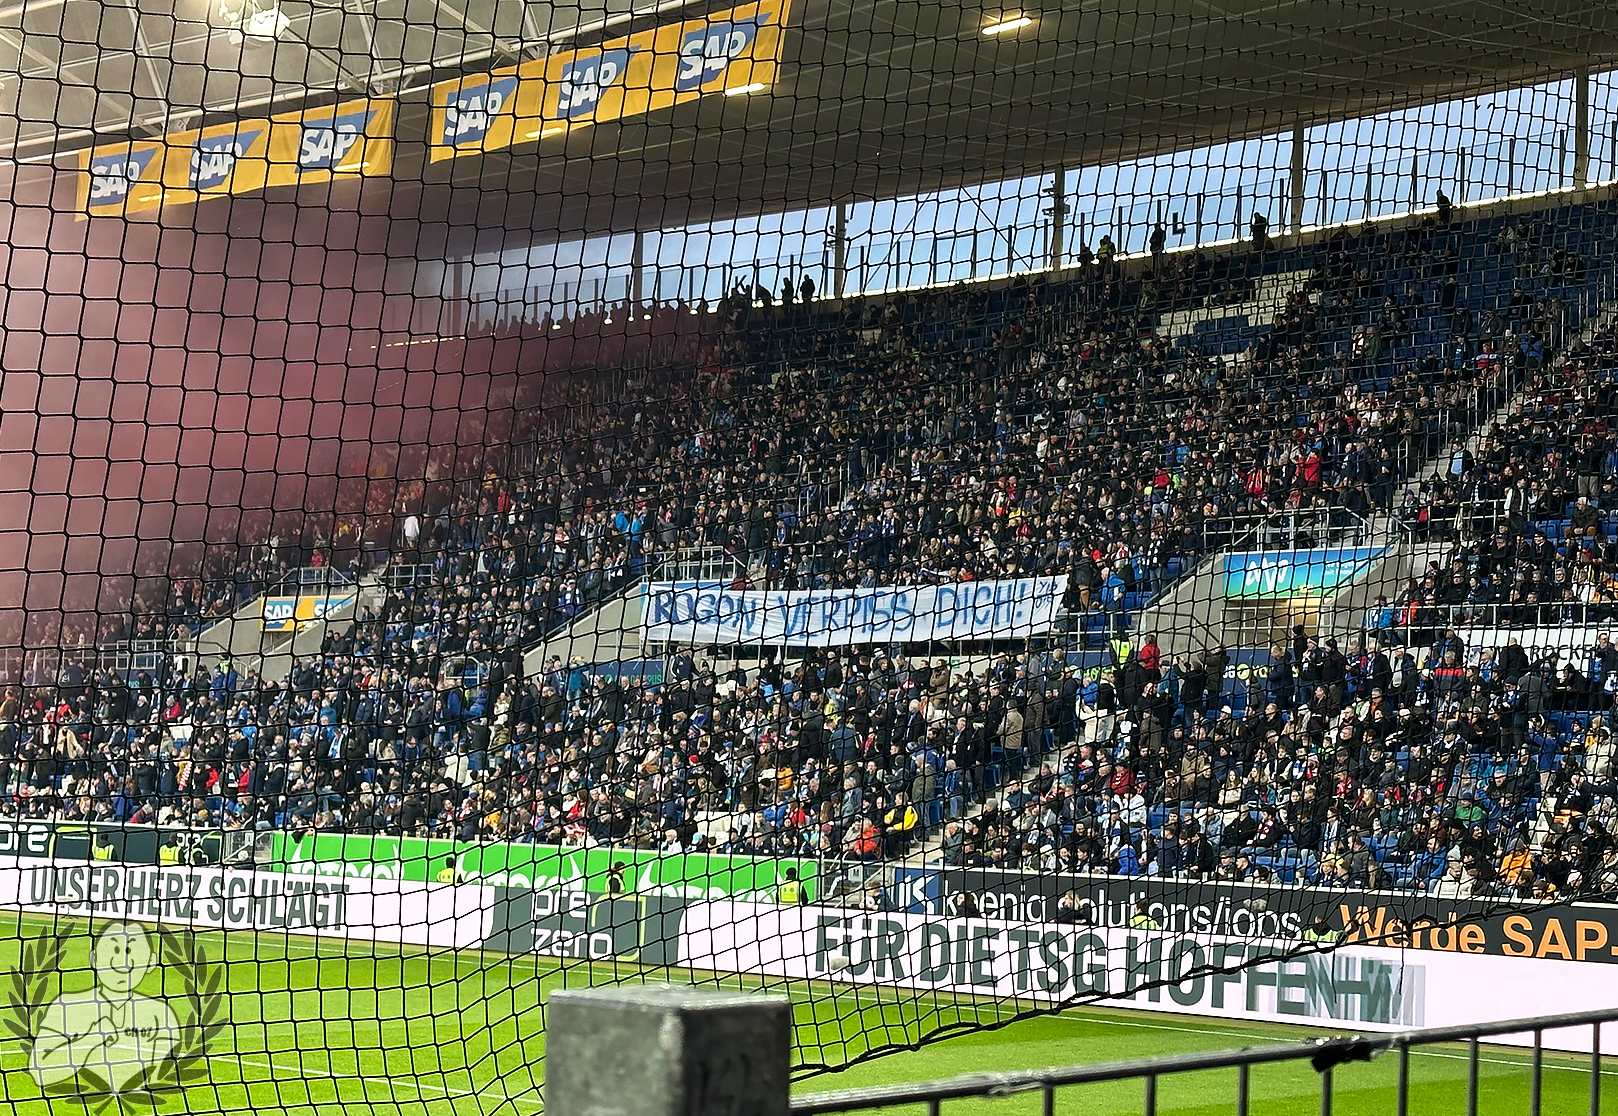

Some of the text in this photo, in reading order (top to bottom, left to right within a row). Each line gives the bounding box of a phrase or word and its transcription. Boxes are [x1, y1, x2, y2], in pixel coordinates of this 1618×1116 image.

[443, 29, 747, 137] SAP SAP SAP
[92, 124, 357, 198] SAP SAP SAP
[264, 604, 292, 624] SAP
[654, 583, 1026, 638] ROGON VERPISS DICH!
[31, 865, 349, 931] UNSER HERZ SCHLÄGT
[531, 889, 591, 922] pre
[943, 879, 1047, 923] kenig
[530, 928, 613, 960] zero
[816, 915, 905, 978] FÜR
[920, 923, 1000, 988] DIE
[1008, 930, 1106, 993] TSG
[1340, 904, 1486, 953] Werde
